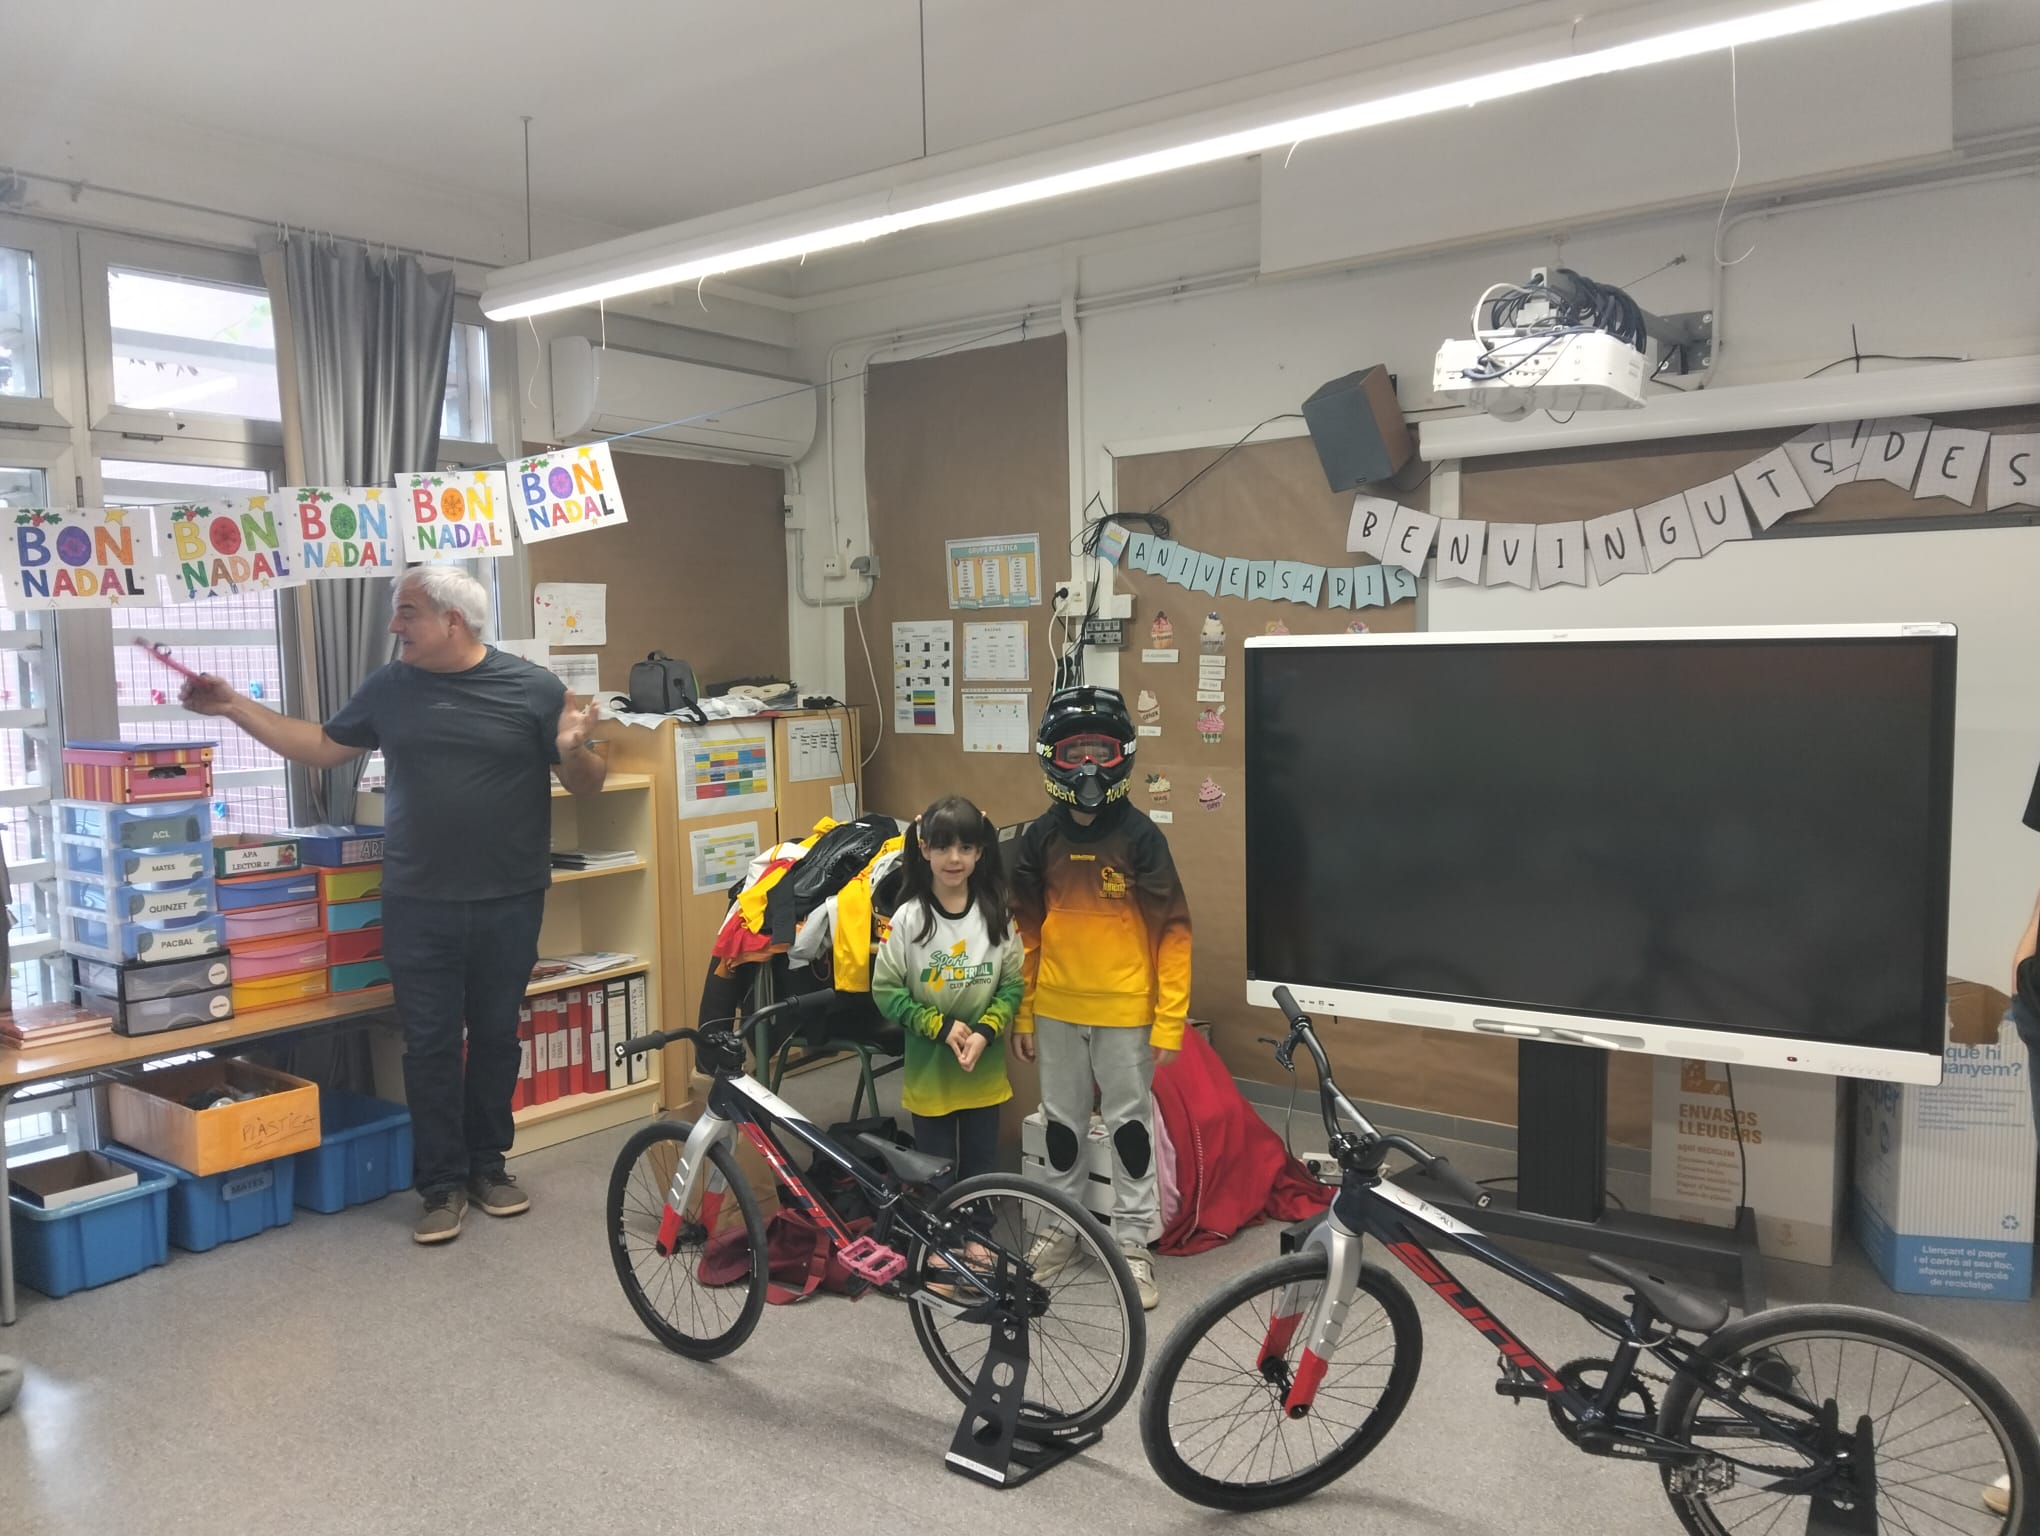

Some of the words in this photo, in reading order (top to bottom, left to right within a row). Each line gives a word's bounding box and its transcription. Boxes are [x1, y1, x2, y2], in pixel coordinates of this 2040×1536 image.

[521, 459, 604, 506] BON
[412, 486, 495, 524] BON
[527, 493, 615, 530] NADAL
[299, 502, 388, 540] BON
[17, 525, 134, 567] BON
[173, 511, 280, 561] BON
[417, 521, 502, 550] NADAL
[304, 541, 392, 568] NADAL
[181, 550, 290, 590] NADAL
[1136, 541, 1413, 597] ANIVERSARIS
[21, 568, 145, 597] NADAL
[152, 831, 171, 839] ACL
[151, 864, 176, 872] MATES
[232, 861, 262, 871] LECTOR
[242, 851, 258, 859] APA
[149, 902, 188, 914] QUINZET
[929, 950, 968, 977] Sport
[588, 990, 604, 1005] 15
[1985, 1046, 2001, 1060] hi
[1679, 1103, 1758, 1126] ENVASOS
[1678, 1119, 1762, 1145] LLEUGERS
[1919, 1256, 1928, 1265] el
[1930, 1256, 1960, 1267] cartró
[1962, 1258, 1972, 1268] al
[1973, 1260, 1992, 1268] seu
[1922, 1245, 1964, 1257] Llençant
[1966, 1247, 1976, 1257] el
[1977, 1249, 2007, 1260] paper
[1930, 1277, 1942, 1287] de
[1963, 1268, 1973, 1278] el
